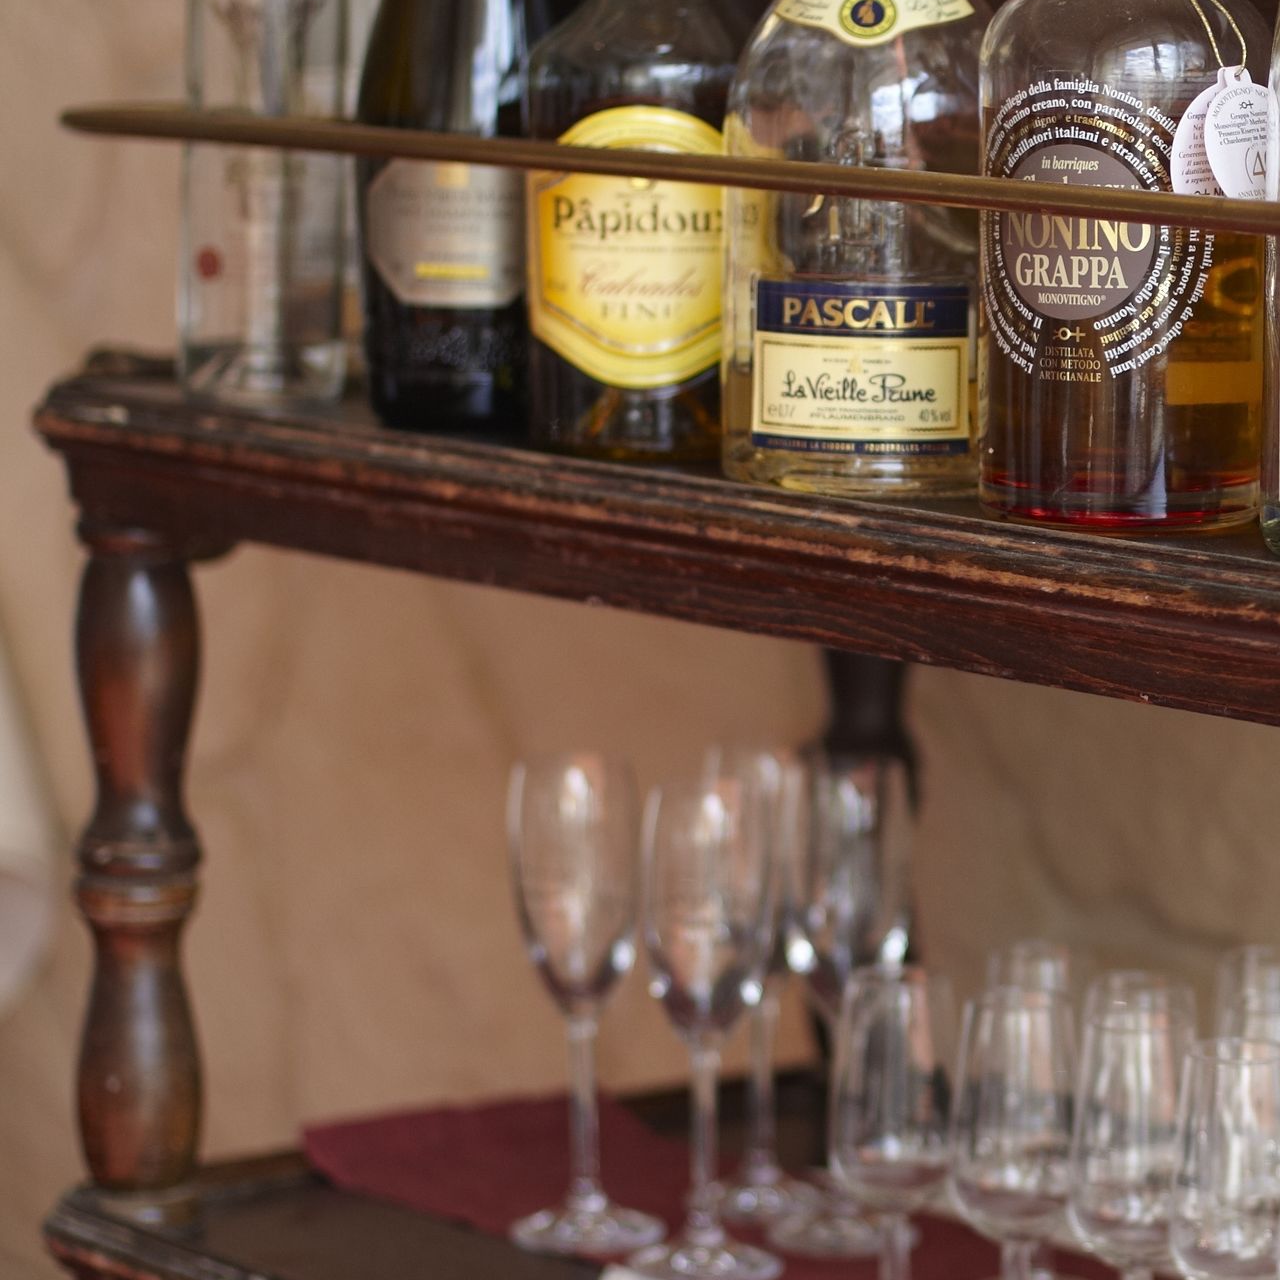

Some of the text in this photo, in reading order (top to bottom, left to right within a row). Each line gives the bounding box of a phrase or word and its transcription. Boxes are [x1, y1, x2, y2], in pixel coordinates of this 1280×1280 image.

[1029, 80, 1052, 96] della
[1054, 78, 1100, 94] famiglia
[1102, 84, 1145, 113] Nonino,
[1002, 106, 1031, 132] Nonino
[1031, 98, 1069, 112] creano,
[1071, 98, 1092, 110] con
[1094, 102, 1155, 137] particolari
[1073, 114, 1135, 144] trasformano
[1134, 138, 1146, 153] la
[1007, 128, 1053, 168] distillatori
[1055, 126, 1100, 143] italiani
[1101, 137, 1109, 146] e
[1110, 140, 1157, 184] stranieri
[1041, 155, 1100, 174] in barriques
[1006, 211, 1151, 252] NONINO
[1199, 234, 1215, 269] Friuli,
[1015, 252, 1128, 289] GRAPPA
[1173, 256, 1195, 295] vapore,
[1003, 279, 1034, 320] successo
[1093, 245, 1171, 331] il modello Nonino
[1187, 272, 1209, 304] Italia,
[1139, 306, 1154, 323] dei
[1152, 298, 1179, 329] nuove
[1180, 306, 1194, 321] da
[1021, 341, 1037, 358] Nel
[1100, 319, 1141, 347] distillati
[1104, 327, 1153, 361] acquaviti
[1161, 321, 1183, 346] oltre
[1040, 358, 1101, 370] CON METODO
[1045, 346, 1095, 358] DISTILLATA
[781, 370, 937, 403] La Vieille Prune
[1040, 370, 1102, 382] ARTIGIANALE
